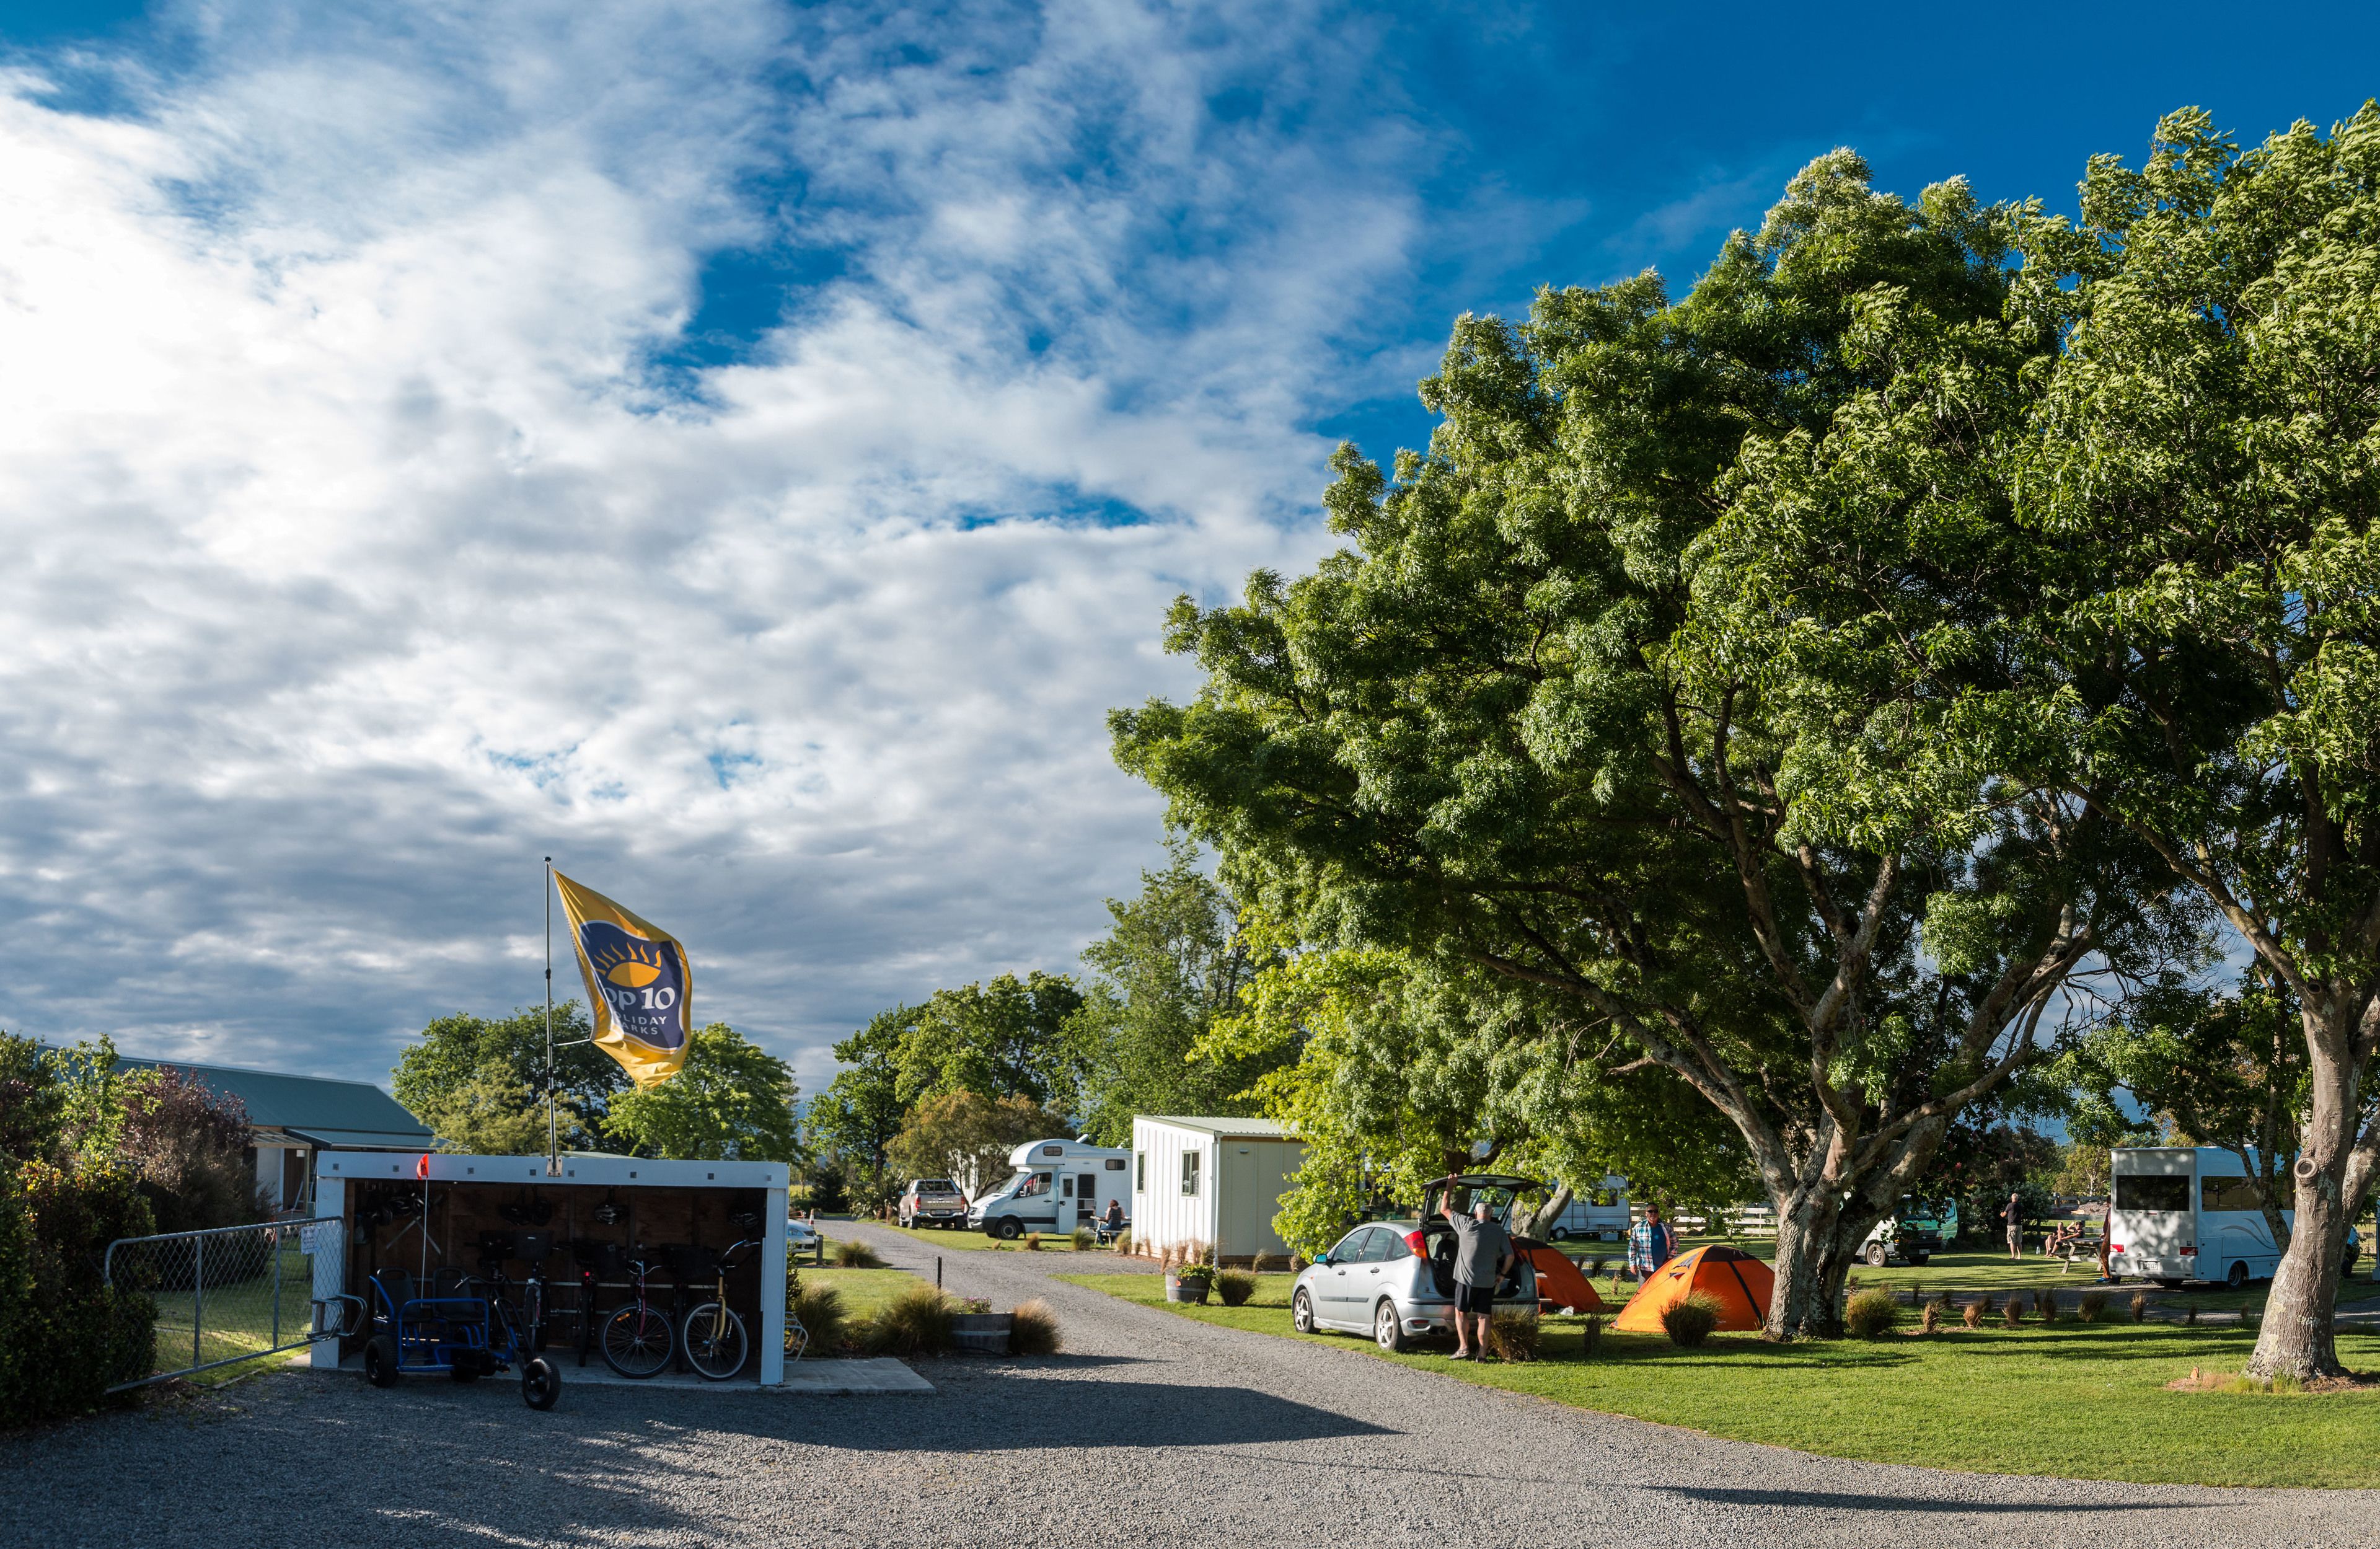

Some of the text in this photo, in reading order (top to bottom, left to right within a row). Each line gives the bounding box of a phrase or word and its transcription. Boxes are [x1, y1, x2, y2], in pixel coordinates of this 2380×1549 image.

[604, 987, 676, 1010] op 10
[614, 1010, 667, 1025] OLIDAY
[622, 1022, 658, 1035] ARKS
